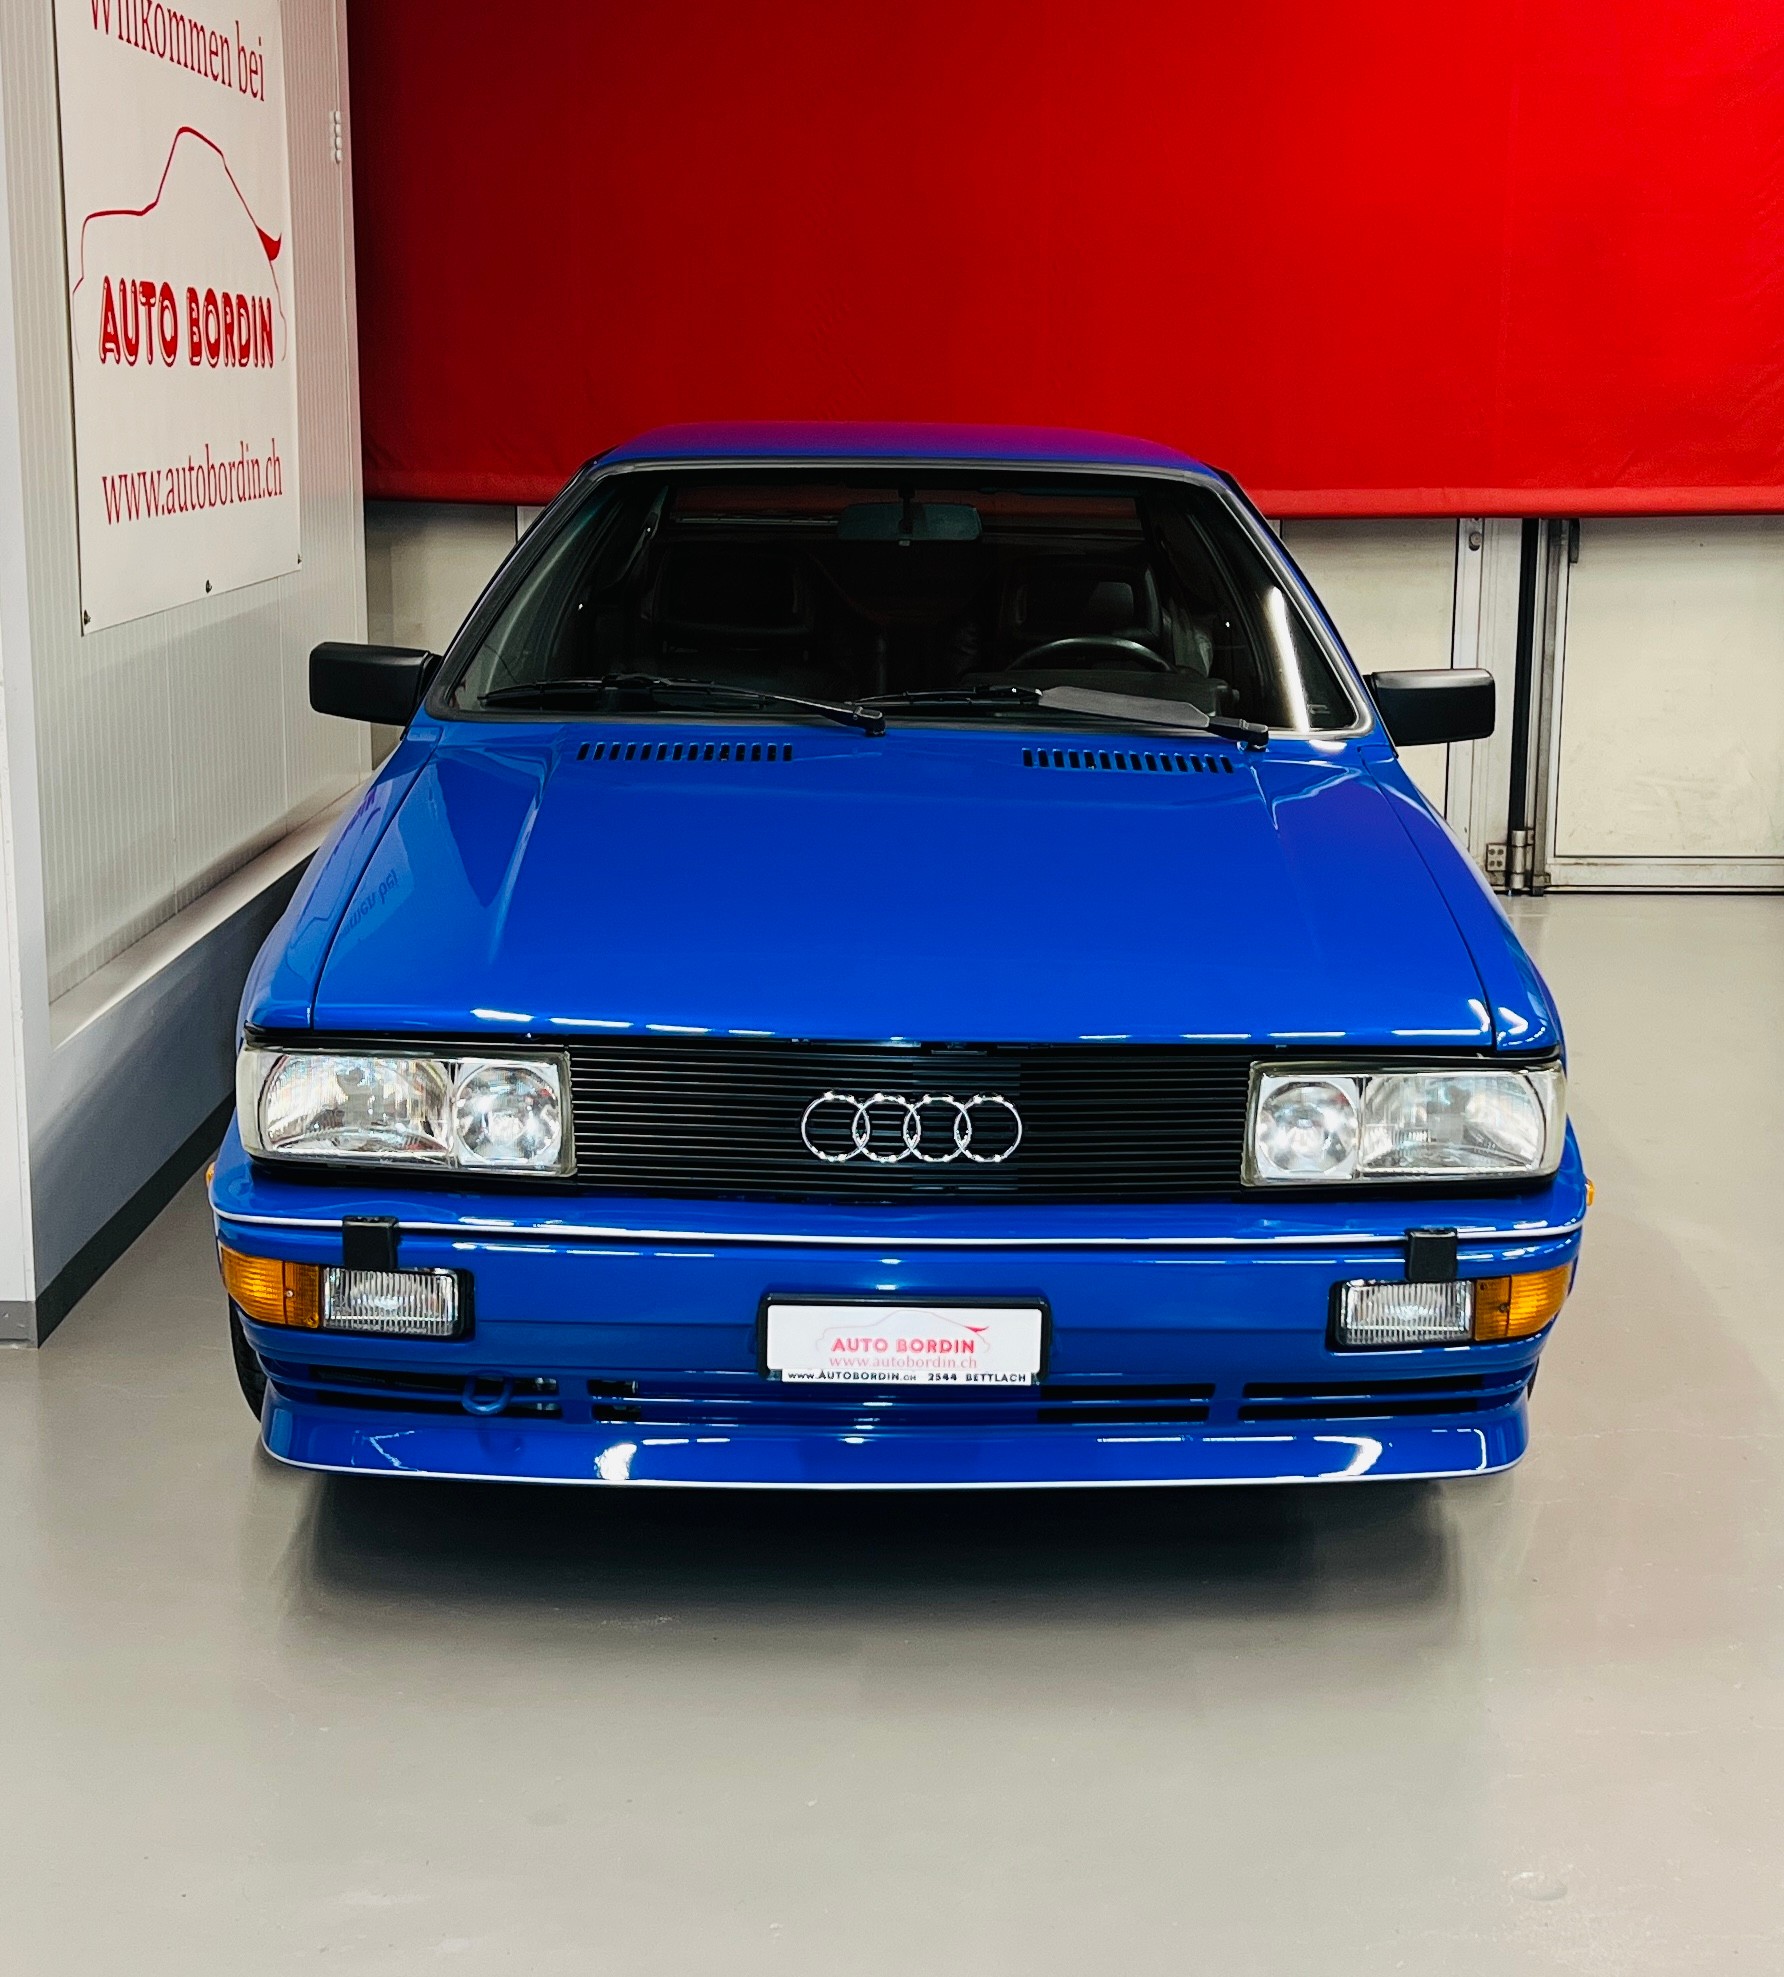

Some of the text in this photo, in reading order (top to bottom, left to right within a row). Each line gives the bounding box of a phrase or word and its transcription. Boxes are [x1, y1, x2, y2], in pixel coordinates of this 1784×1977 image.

[235, 20, 264, 101] bei
[99, 275, 275, 369] AUTO BORDIN
[102, 438, 283, 525] www.autobordin.ch
[829, 1355, 976, 1369] www.autobordin.ch
[831, 1338, 975, 1354] AUTO BORDIN
[928, 1372, 957, 1381] 2544
[965, 1372, 1026, 1383] BETTLACH
